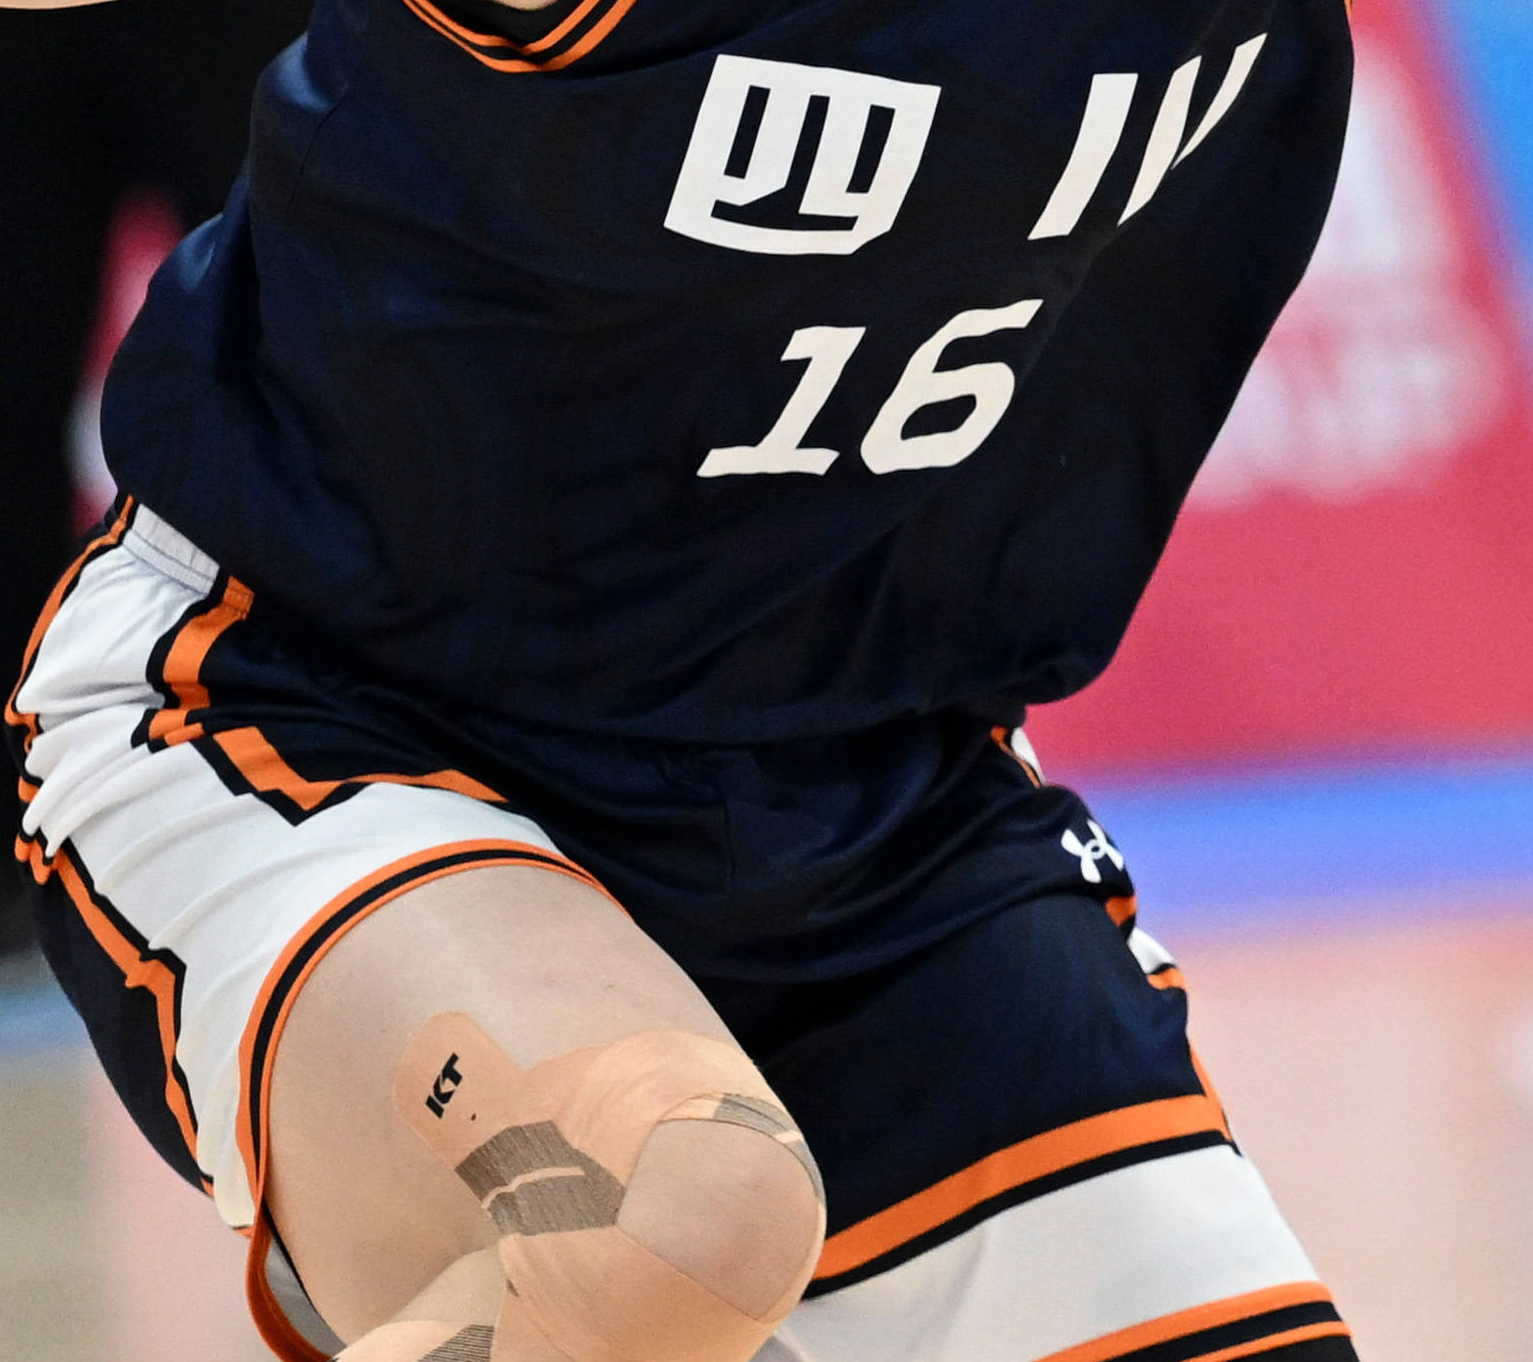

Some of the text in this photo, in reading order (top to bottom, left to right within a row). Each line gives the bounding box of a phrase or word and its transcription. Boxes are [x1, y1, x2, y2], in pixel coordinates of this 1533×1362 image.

[663, 33, 1268, 255] 四川
[696, 298, 1044, 479] 16
[424, 1051, 464, 1120] KT
